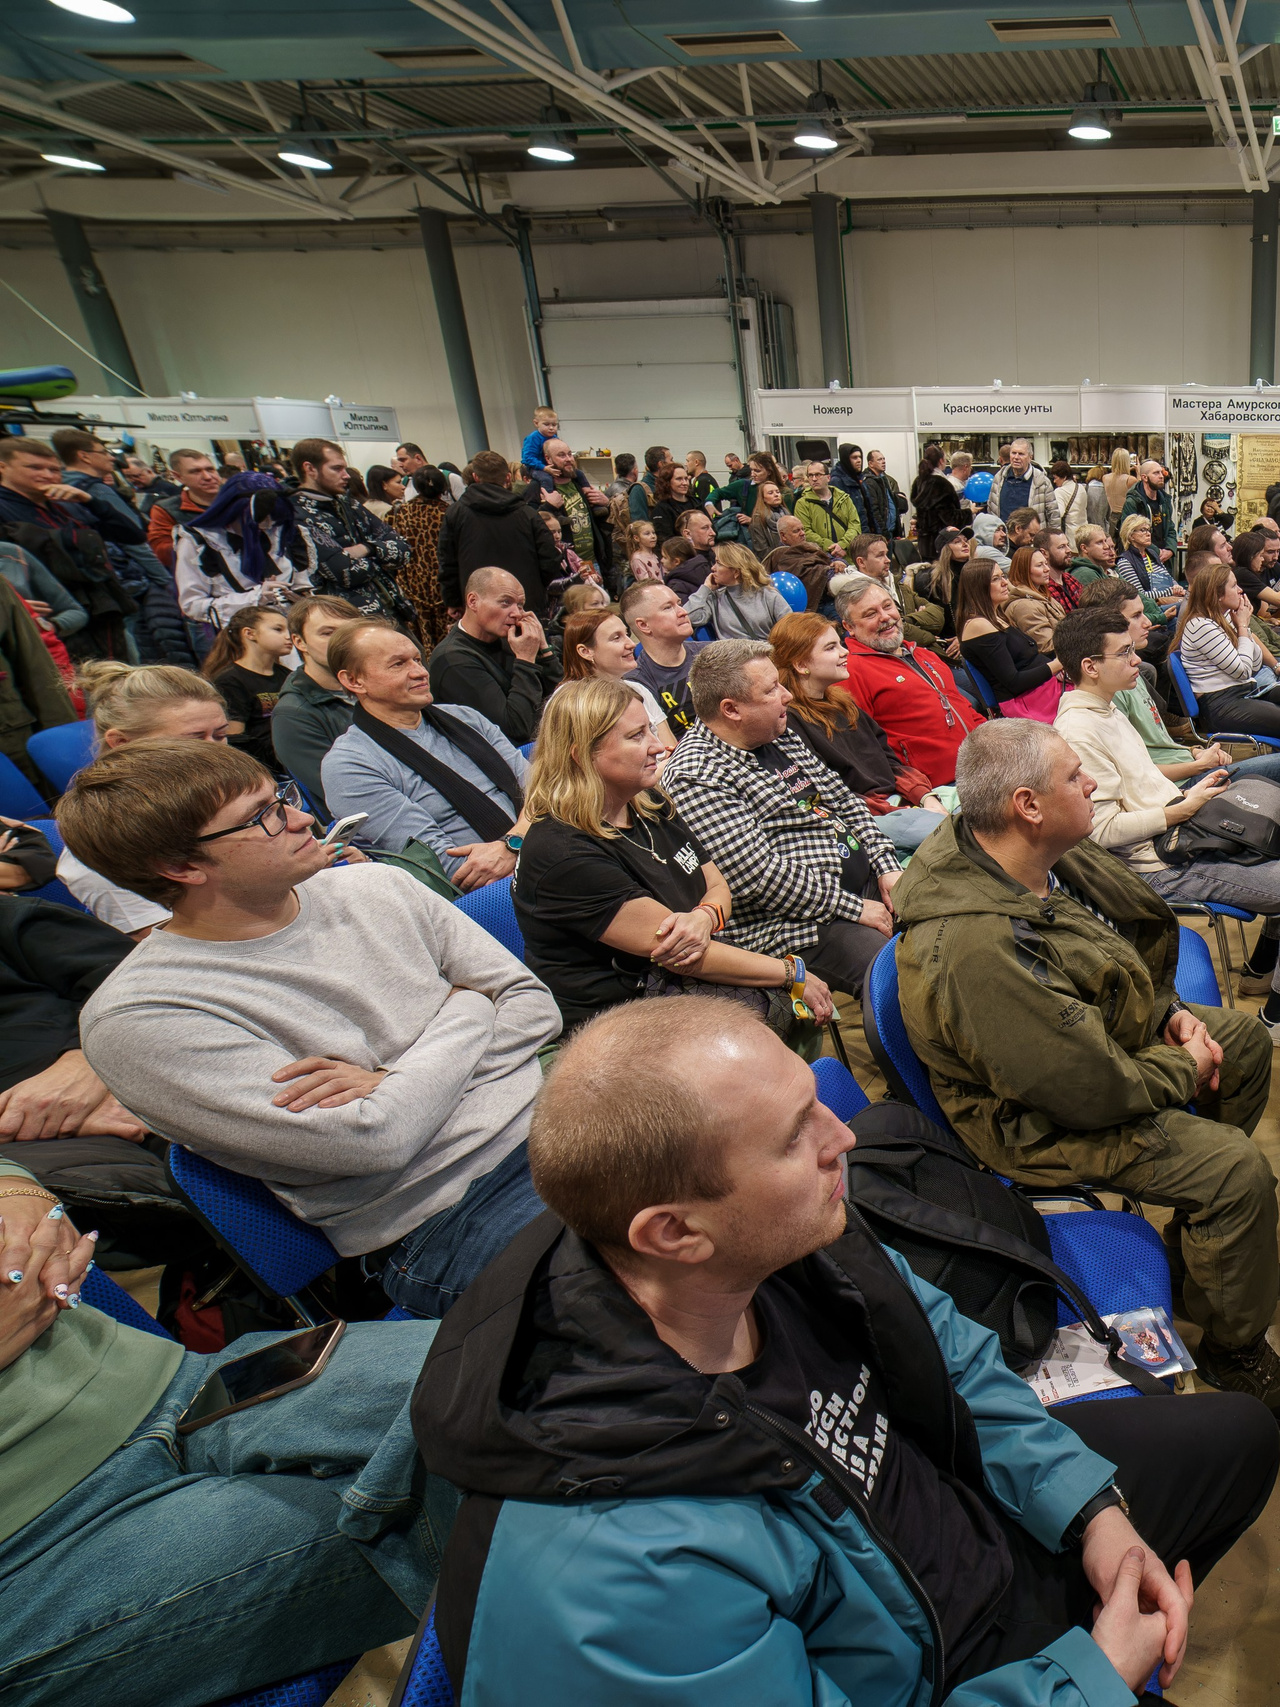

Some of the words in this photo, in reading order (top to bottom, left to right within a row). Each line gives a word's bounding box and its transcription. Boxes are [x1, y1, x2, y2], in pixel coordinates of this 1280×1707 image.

[813, 404, 854, 416] Ножеяр
[943, 403, 1021, 415] Красноярские
[1024, 404, 1053, 415] унты
[1172, 399, 1222, 411] Мастера
[148, 412, 180, 422] Милла
[349, 413, 379, 422] Милла
[343, 421, 389, 431] Юлтыгина
[931, 918, 949, 963] MBLER
[815, 1392, 845, 1449] UCH
[832, 1363, 871, 1471] ECTION
